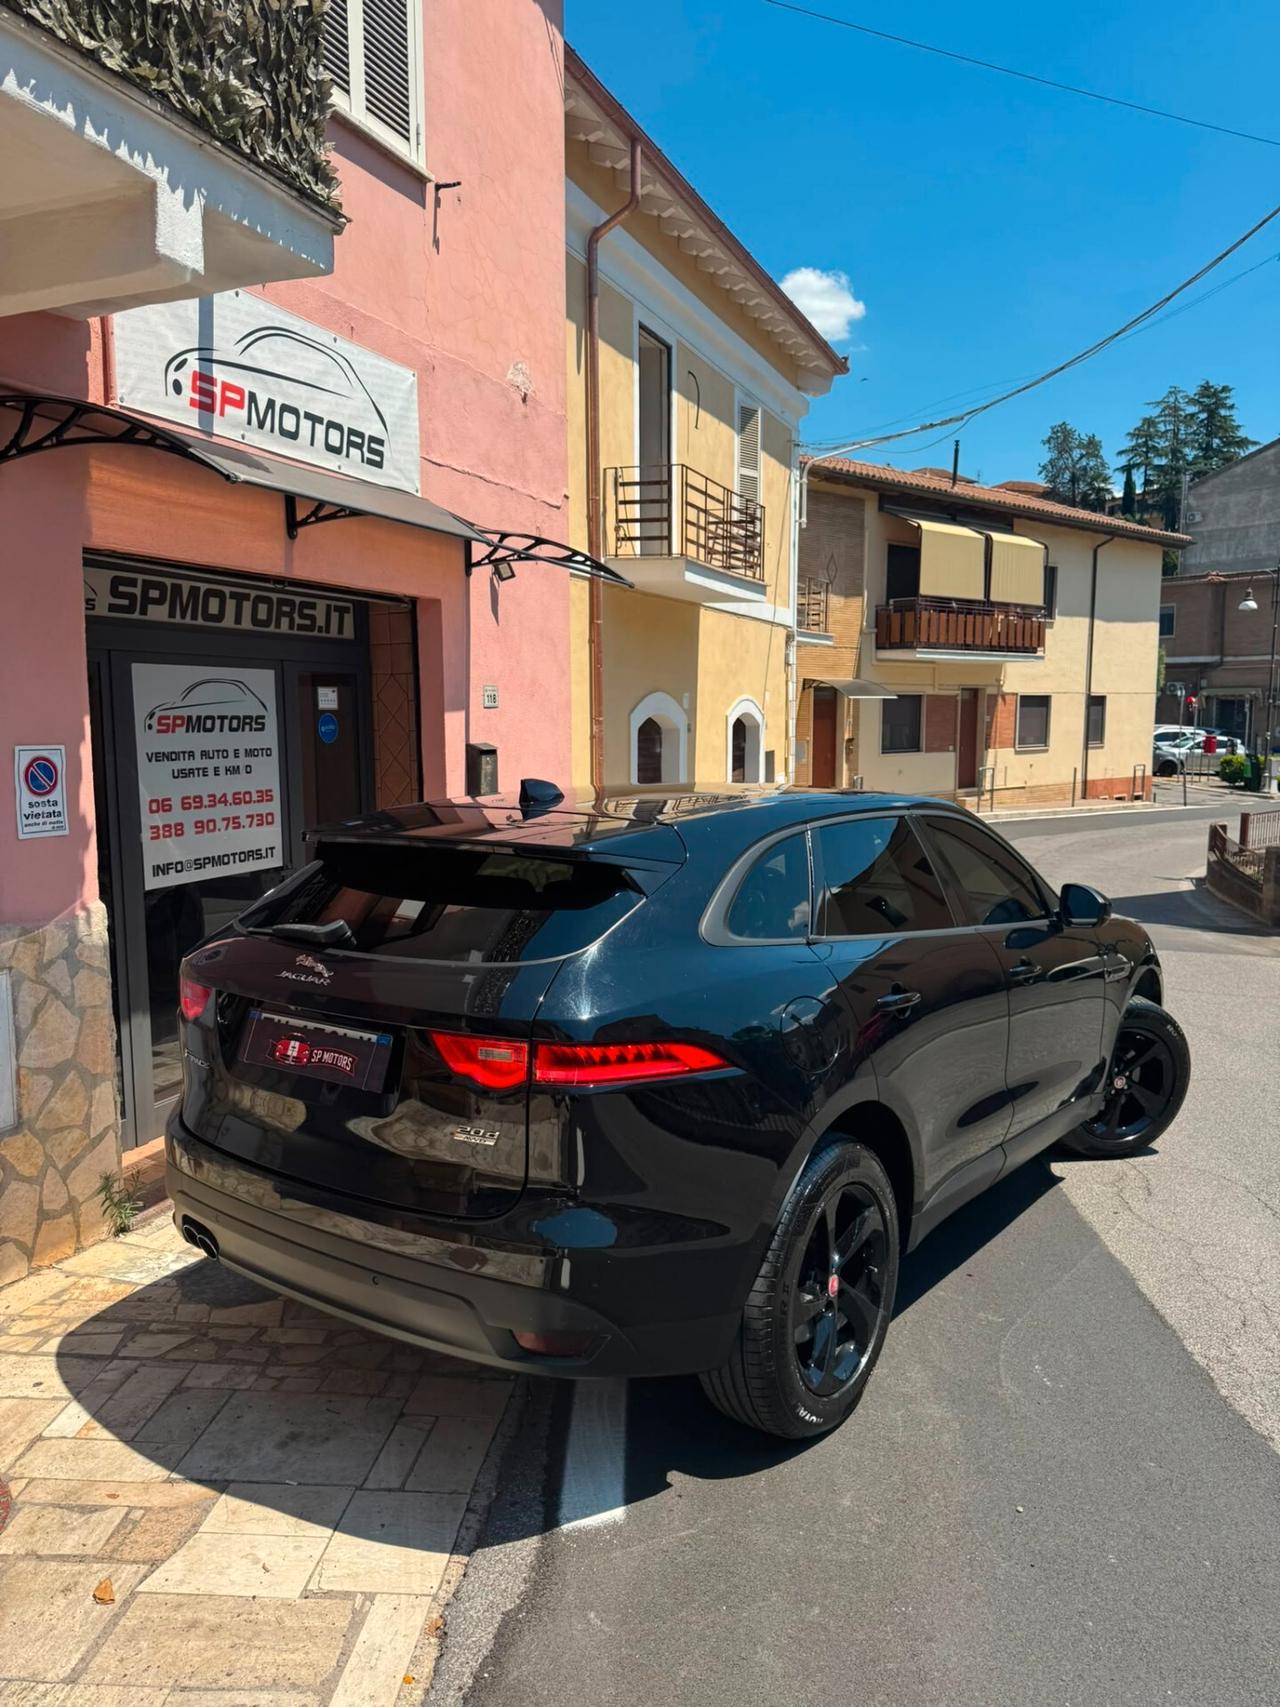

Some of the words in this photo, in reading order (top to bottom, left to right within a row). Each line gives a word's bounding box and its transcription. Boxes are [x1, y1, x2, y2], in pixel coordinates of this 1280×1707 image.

[189, 369, 385, 470] SPMOTORS
[107, 575, 352, 637] SPMOTORS.IT
[486, 694, 496, 704] 118
[156, 714, 266, 734] SPMOTORS
[145, 750, 195, 763] VENDITA
[200, 749, 229, 761] AUTO
[233, 749, 240, 759] E
[244, 747, 273, 759] MOTO
[171, 767, 209, 780] USATE
[213, 767, 221, 777] E
[225, 765, 241, 776] KM
[27, 799, 58, 809] sosta
[148, 797, 173, 814] 06
[180, 789, 274, 812] 69.34.60.35
[23, 810, 62, 820] vietata
[149, 822, 185, 841] 388
[194, 812, 275, 835] 90.75.730
[152, 846, 276, 878] INFO@SPMOTORS.IT
[274, 970, 332, 986] JAGUAR
[311, 1049, 321, 1062] SP
[321, 1051, 353, 1071] MOTORS
